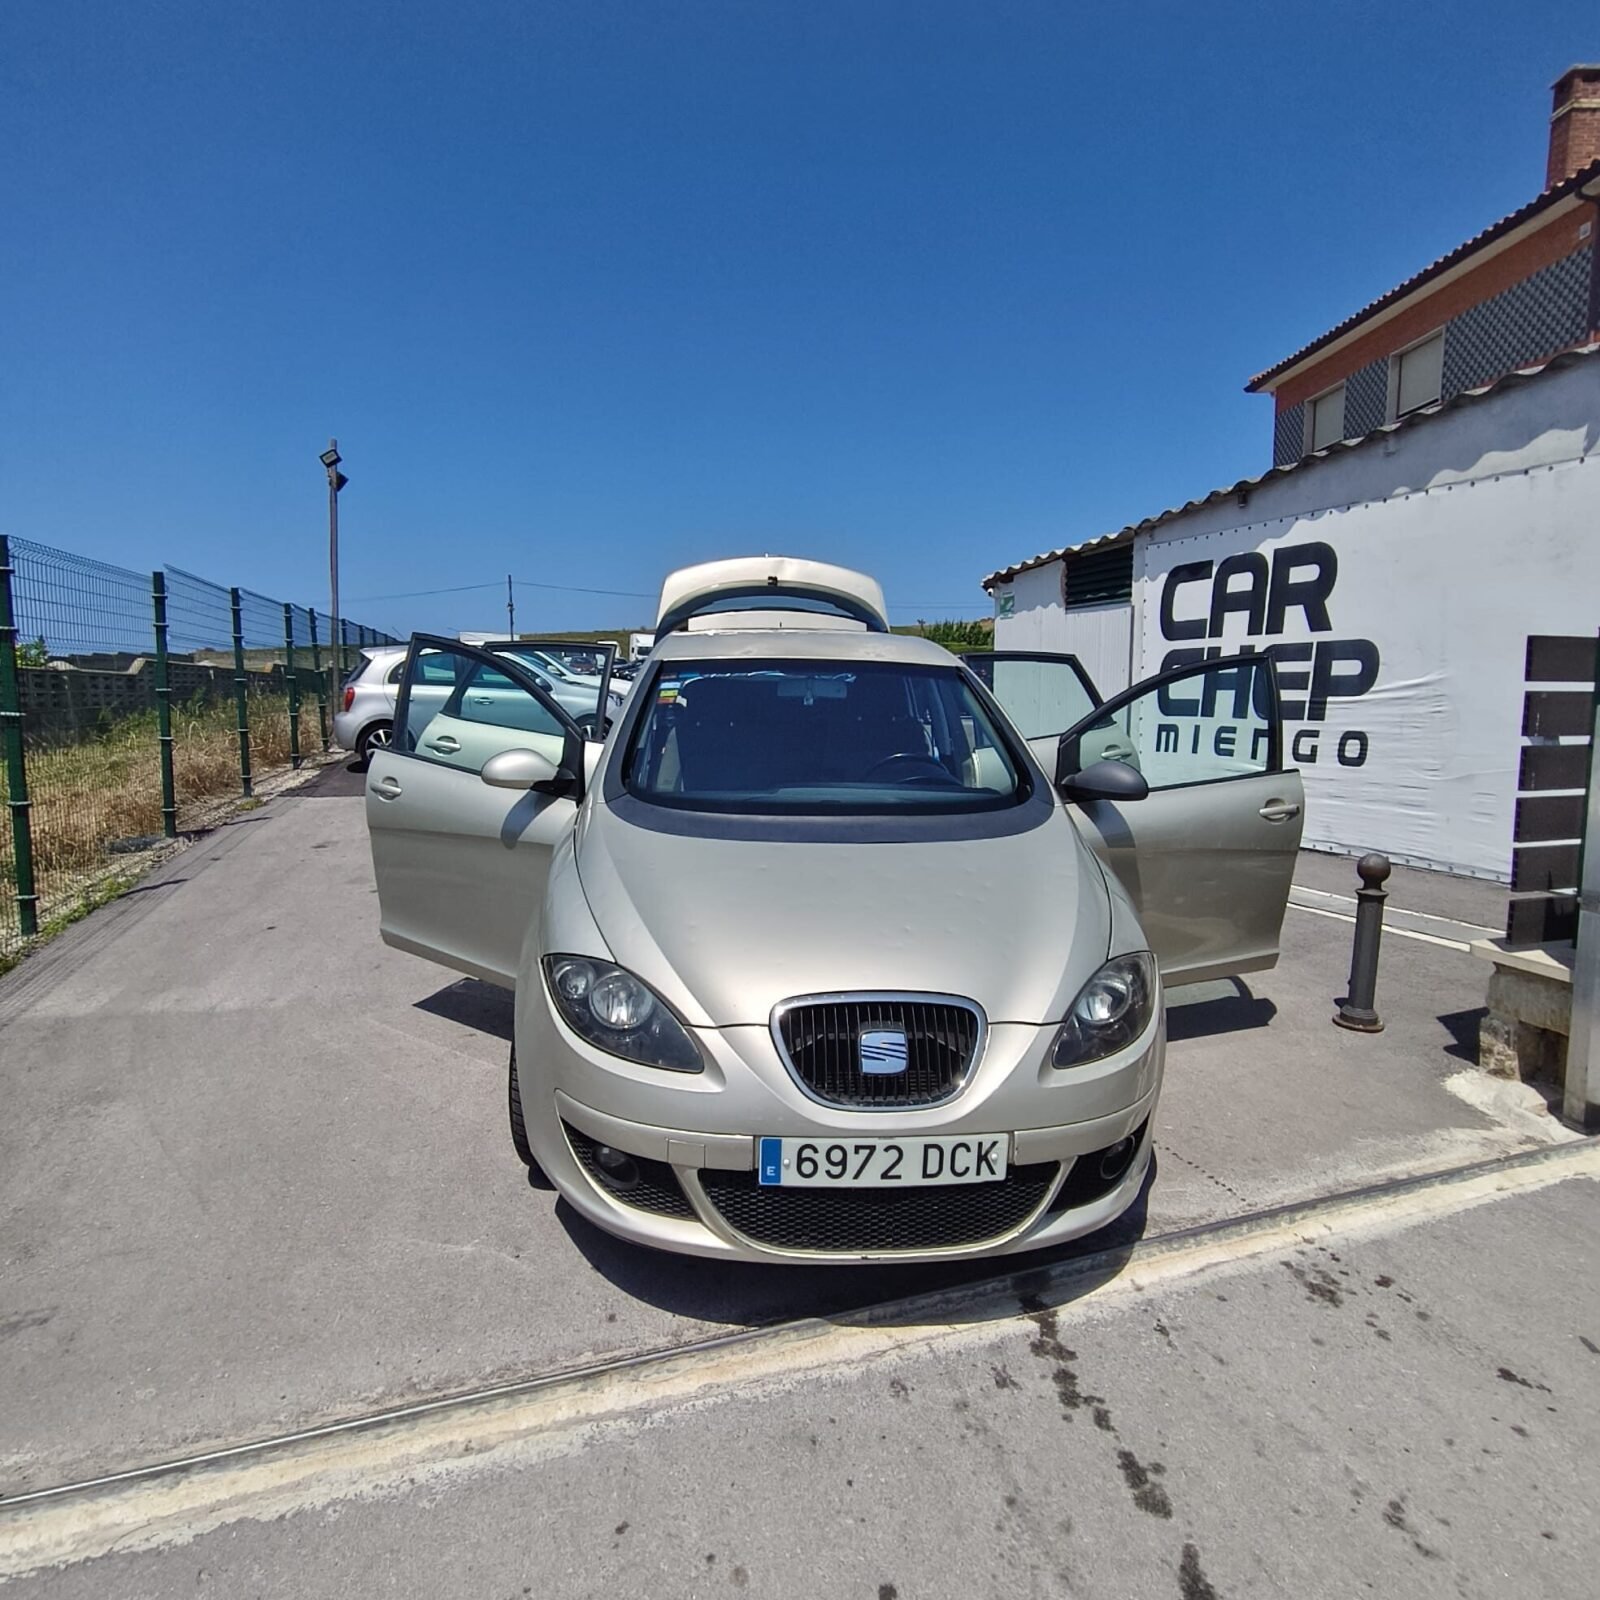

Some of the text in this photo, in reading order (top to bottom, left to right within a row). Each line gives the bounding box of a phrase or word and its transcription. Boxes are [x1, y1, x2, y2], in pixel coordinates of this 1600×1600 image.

[1160, 541, 1338, 641] CAR
[1157, 639, 1380, 721] CHEP
[766, 1166, 776, 1176] E
[796, 1140, 999, 1180] 6972 DCK
